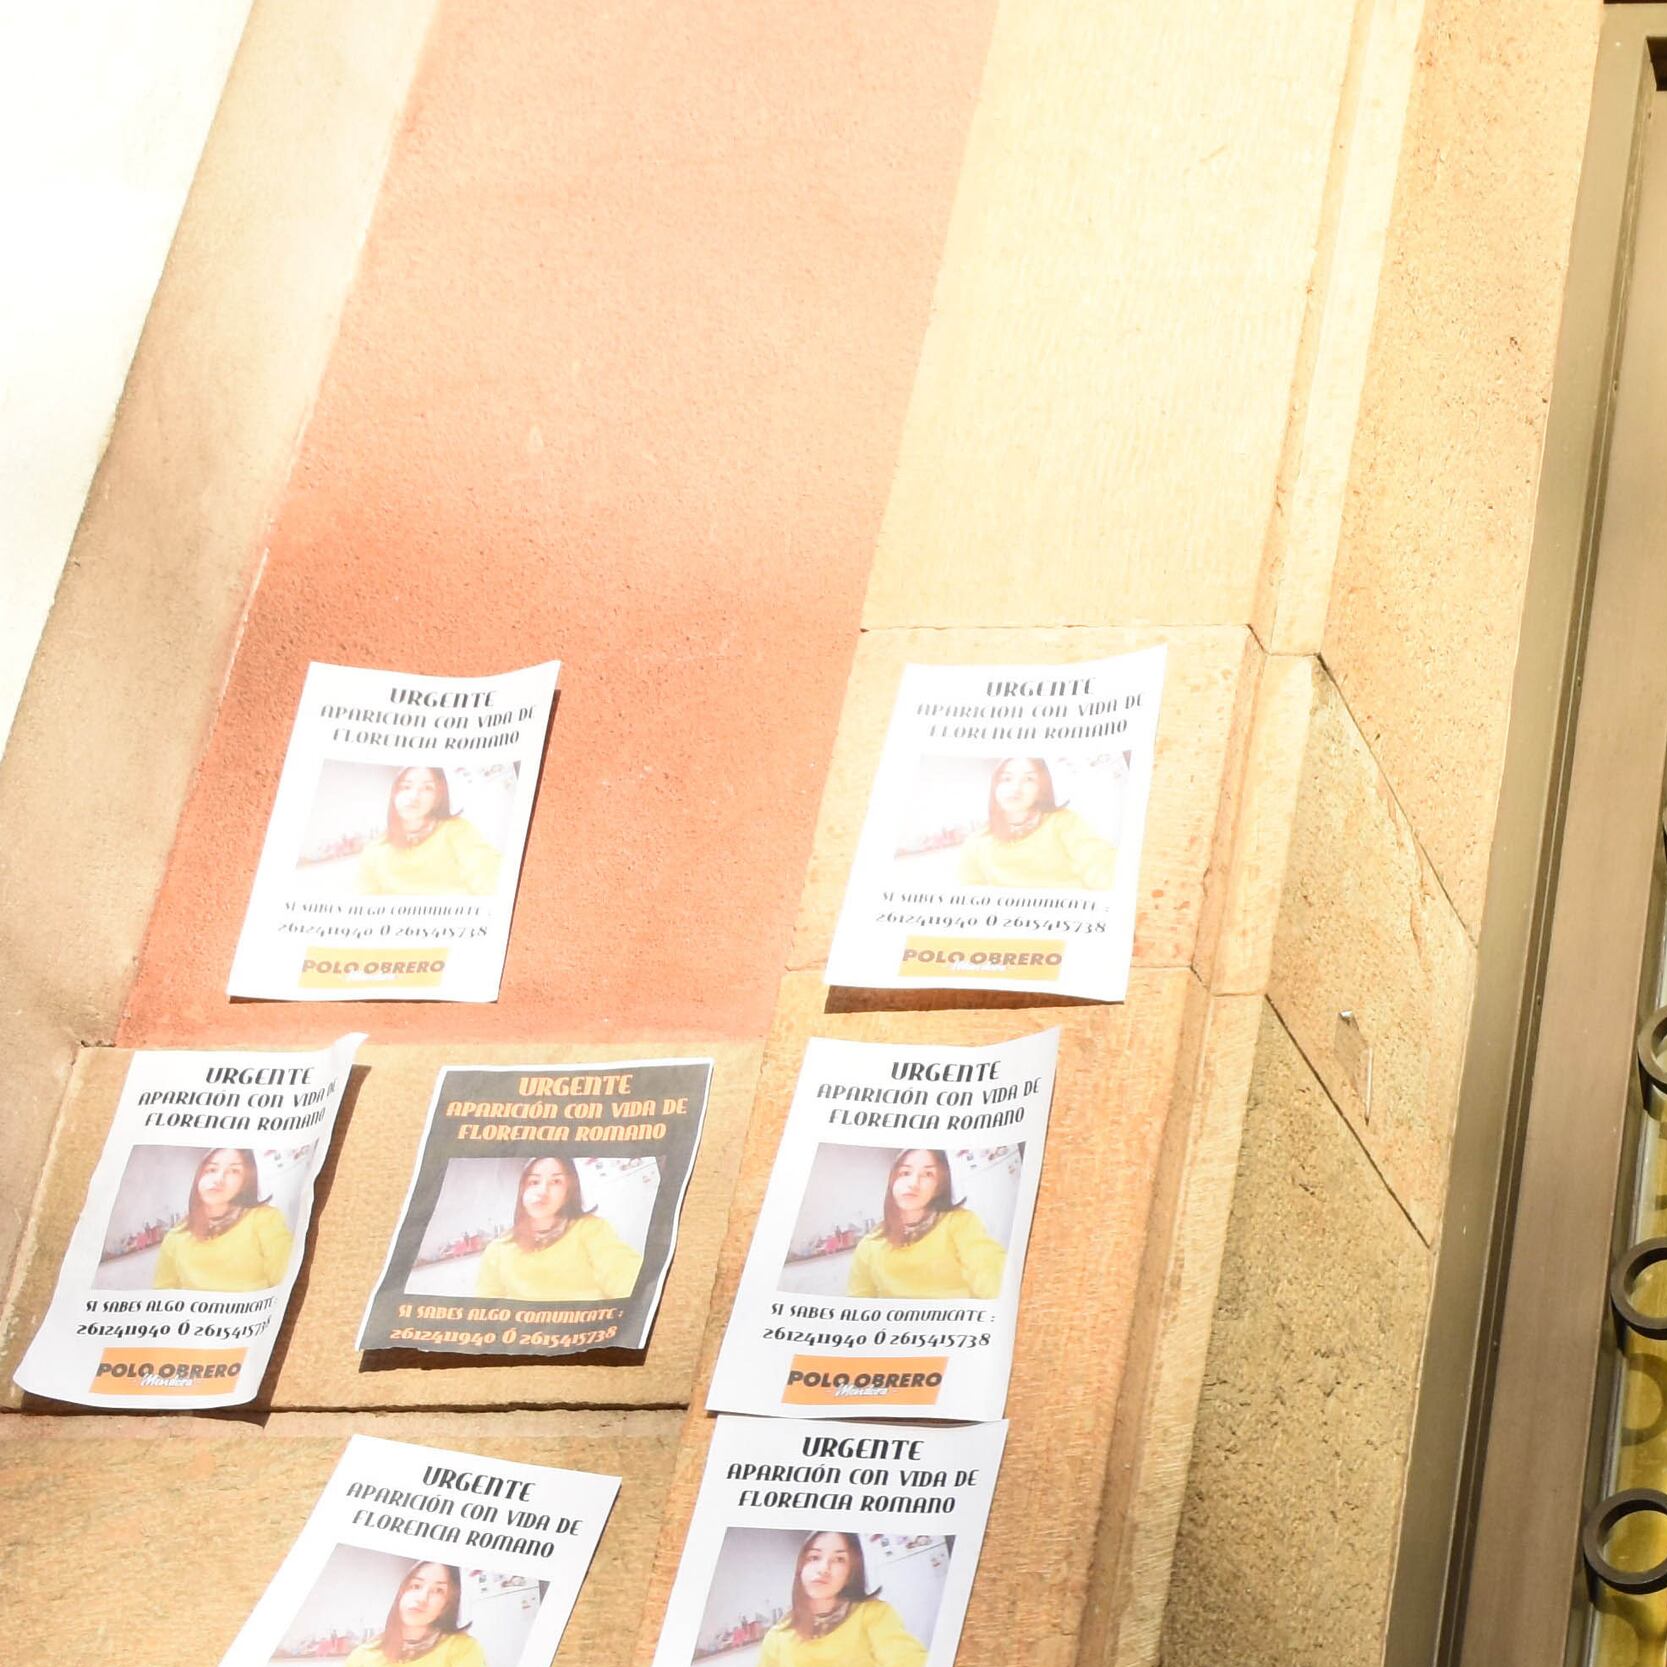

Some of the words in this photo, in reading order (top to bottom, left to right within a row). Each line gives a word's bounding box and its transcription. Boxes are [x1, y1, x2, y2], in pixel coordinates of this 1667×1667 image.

[390, 687, 497, 708] URGENTE
[445, 731, 519, 750] ROMANO
[902, 949, 964, 963] POLO
[970, 952, 1062, 965] OBRERO
[206, 1067, 315, 1085] URGENTE
[891, 1061, 1001, 1082] URGENTE
[519, 1075, 632, 1096] URGENTE
[446, 1100, 558, 1119] APARICIÓN
[564, 1103, 601, 1119] CON
[611, 1100, 655, 1117] VIDA
[662, 1098, 688, 1114] DE
[829, 1109, 940, 1129] FLORENCIA
[947, 1107, 1024, 1130] ROMANO
[145, 1112, 250, 1130] FLORENCIA
[257, 1108, 326, 1131] ROMANO
[458, 1124, 570, 1141] FLORENCIA
[575, 1123, 666, 1141] ROMANO
[802, 1437, 924, 1461] URGENTE
[422, 1466, 536, 1502] URGENTE
[727, 1463, 841, 1484] APARICIÓN
[850, 1469, 889, 1485] CON
[900, 1470, 947, 1487] VIDA
[954, 1469, 979, 1486] DE
[738, 1490, 853, 1510] FLORENCIA
[860, 1495, 955, 1514] ROMANO
[352, 1509, 460, 1543] FLORENCIA
[465, 1530, 554, 1558] ROMANO
